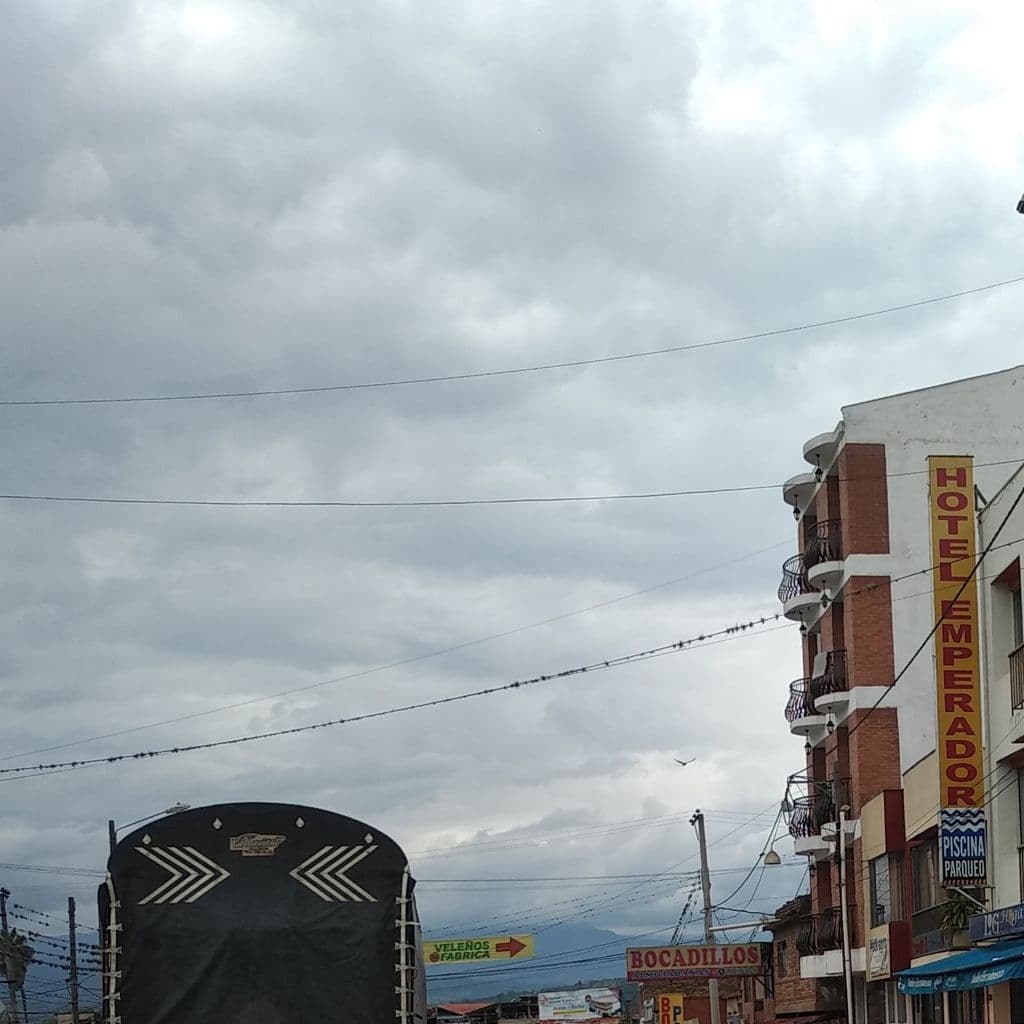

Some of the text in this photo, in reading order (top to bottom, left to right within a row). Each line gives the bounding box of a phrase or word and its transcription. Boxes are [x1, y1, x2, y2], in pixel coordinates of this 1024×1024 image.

[936, 467, 977, 806] HOTEL EMPERADOR
[943, 835, 985, 857] PISCINA
[944, 859, 985, 877] PARQUEO
[433, 941, 490, 952] VELEÑOS
[440, 951, 490, 961] FABRICA
[630, 946, 759, 968] BOCADILLOS
